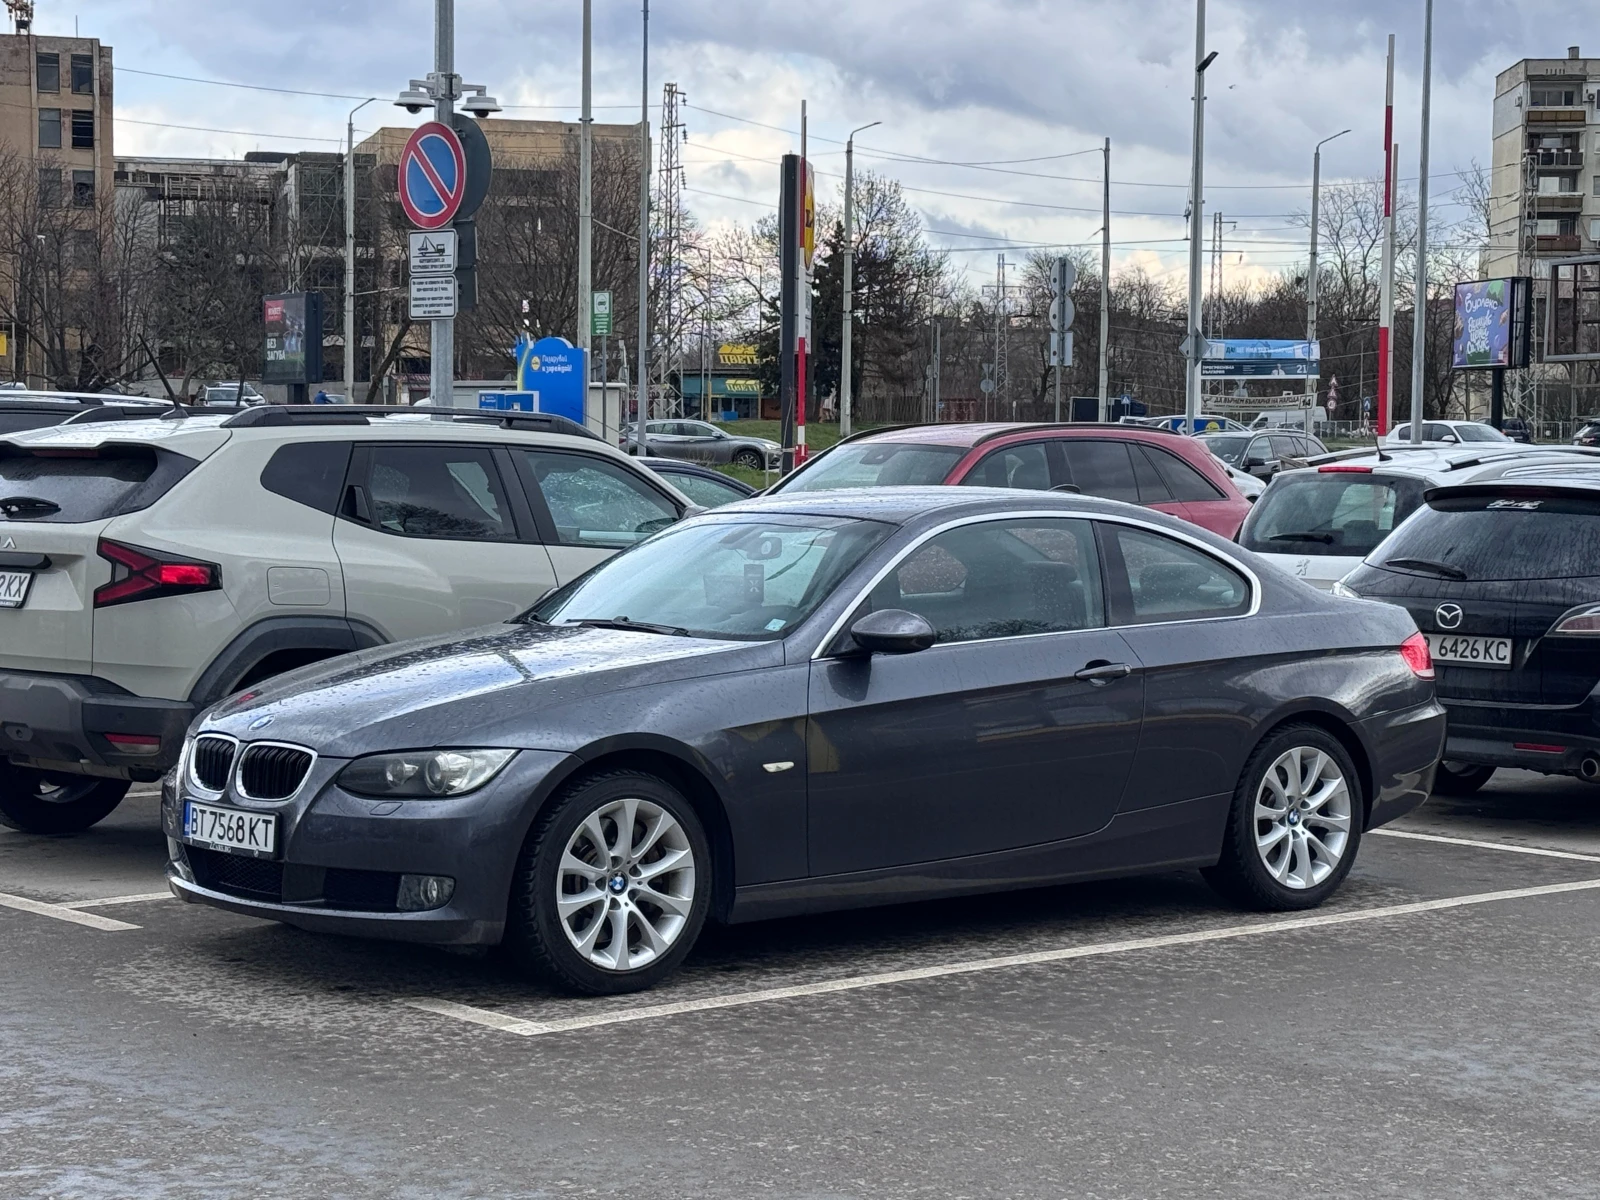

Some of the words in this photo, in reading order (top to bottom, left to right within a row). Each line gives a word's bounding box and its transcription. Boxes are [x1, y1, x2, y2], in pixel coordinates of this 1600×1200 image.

[266, 338, 277, 349] БЕЗ
[266, 350, 286, 361] ЗАГУБА
[1296, 364, 1308, 374] 21
[1279, 396, 1299, 404] НАРОДА
[1301, 398, 1311, 407] 14
